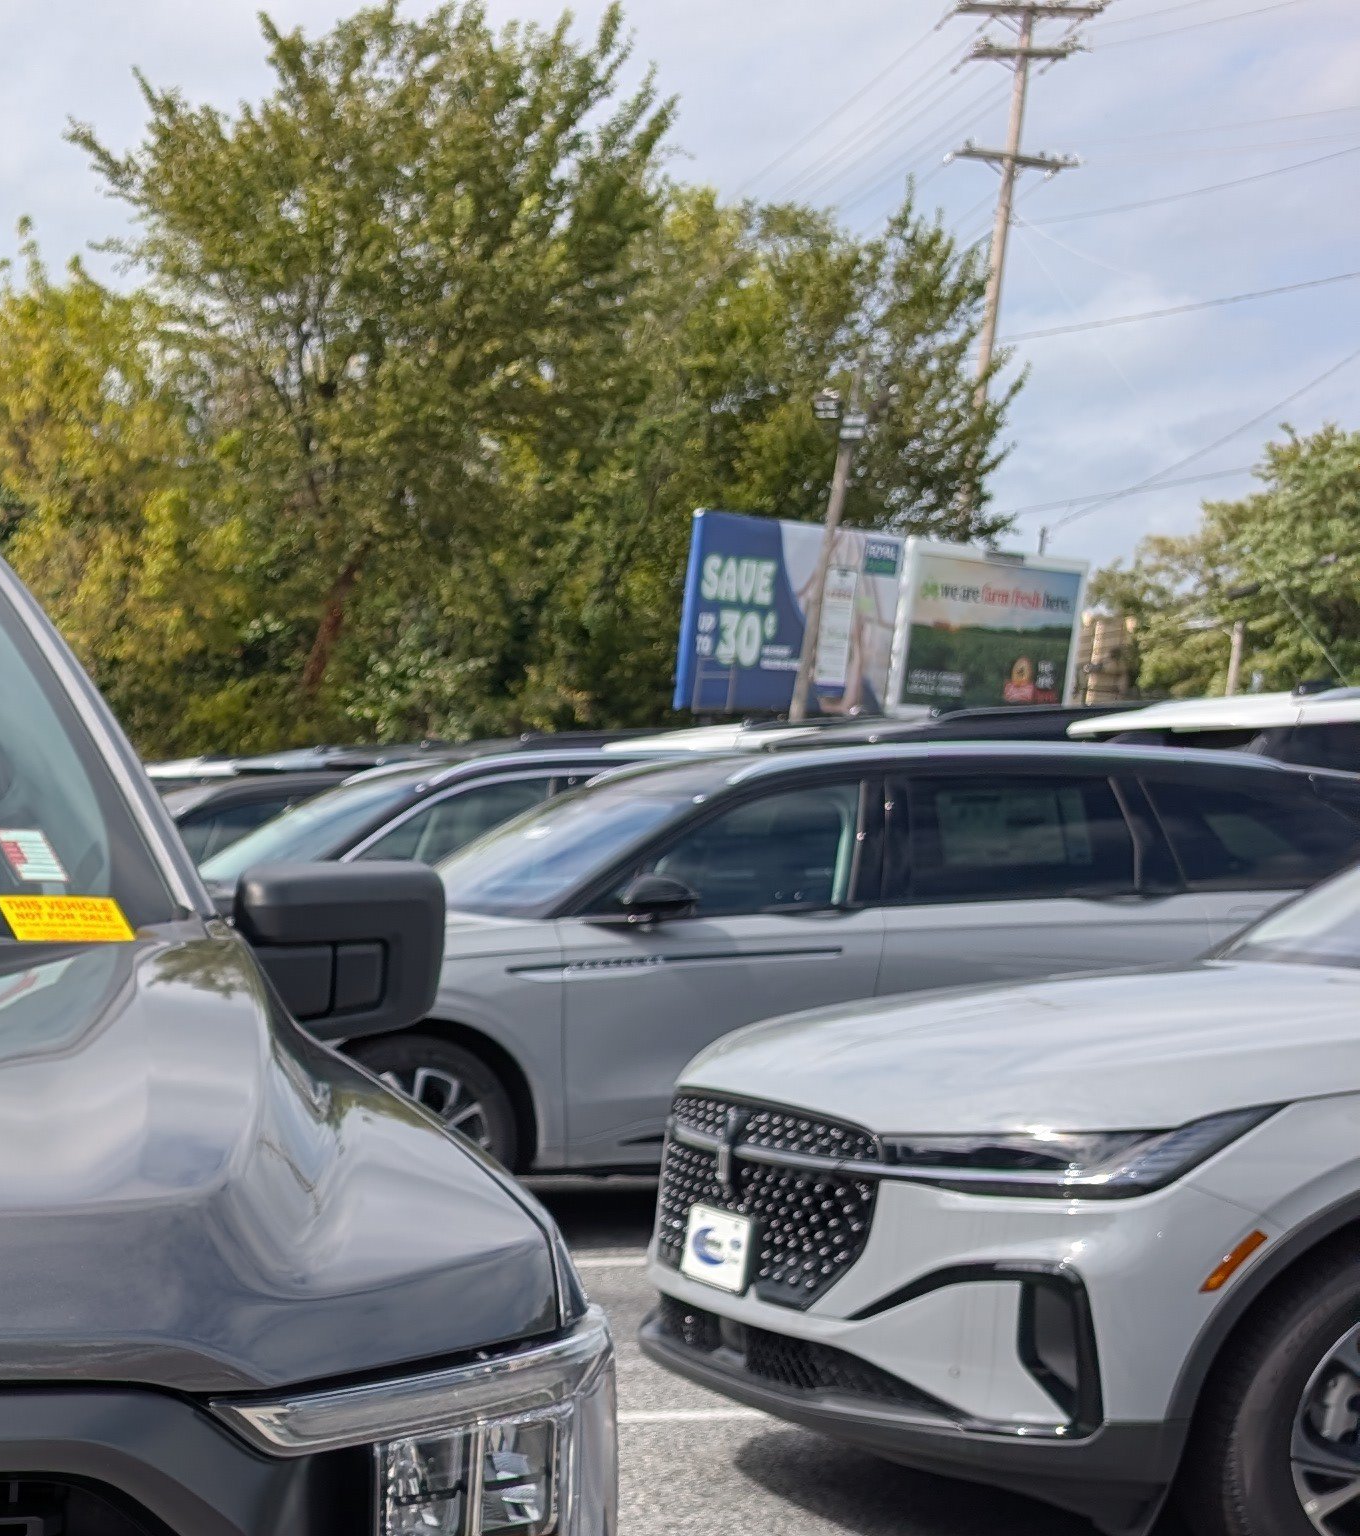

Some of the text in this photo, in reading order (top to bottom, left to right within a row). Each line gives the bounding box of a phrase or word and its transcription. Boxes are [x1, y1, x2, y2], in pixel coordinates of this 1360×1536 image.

[701, 555, 776, 605] SAVE
[6, 900, 112, 912] THIS VEHICLE
[15, 912, 113, 921] NOT FOR SALE
